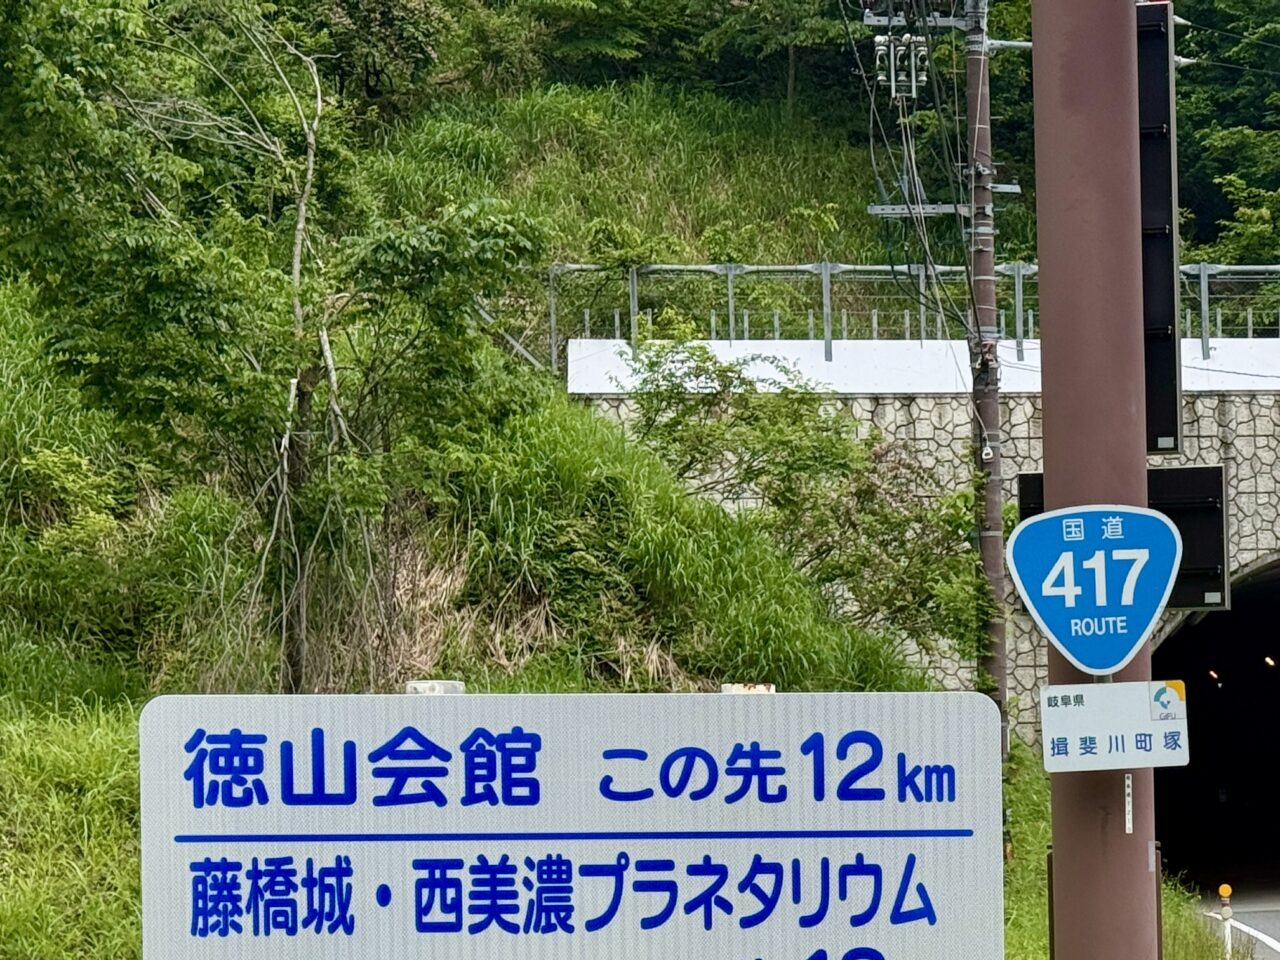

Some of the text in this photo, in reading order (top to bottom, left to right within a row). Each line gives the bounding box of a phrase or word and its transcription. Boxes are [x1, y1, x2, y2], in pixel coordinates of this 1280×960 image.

[1062, 516, 1125, 541] 国道
[1042, 548, 1149, 608] 417
[1071, 616, 1127, 636] ROUTE
[1047, 694, 1085, 708] 岐阜県
[1050, 730, 1182, 757] 揖斐川町塚
[183, 726, 543, 810] 徳山会館
[189, 850, 938, 938] 藤橋城・西美濃プラネタリウム
